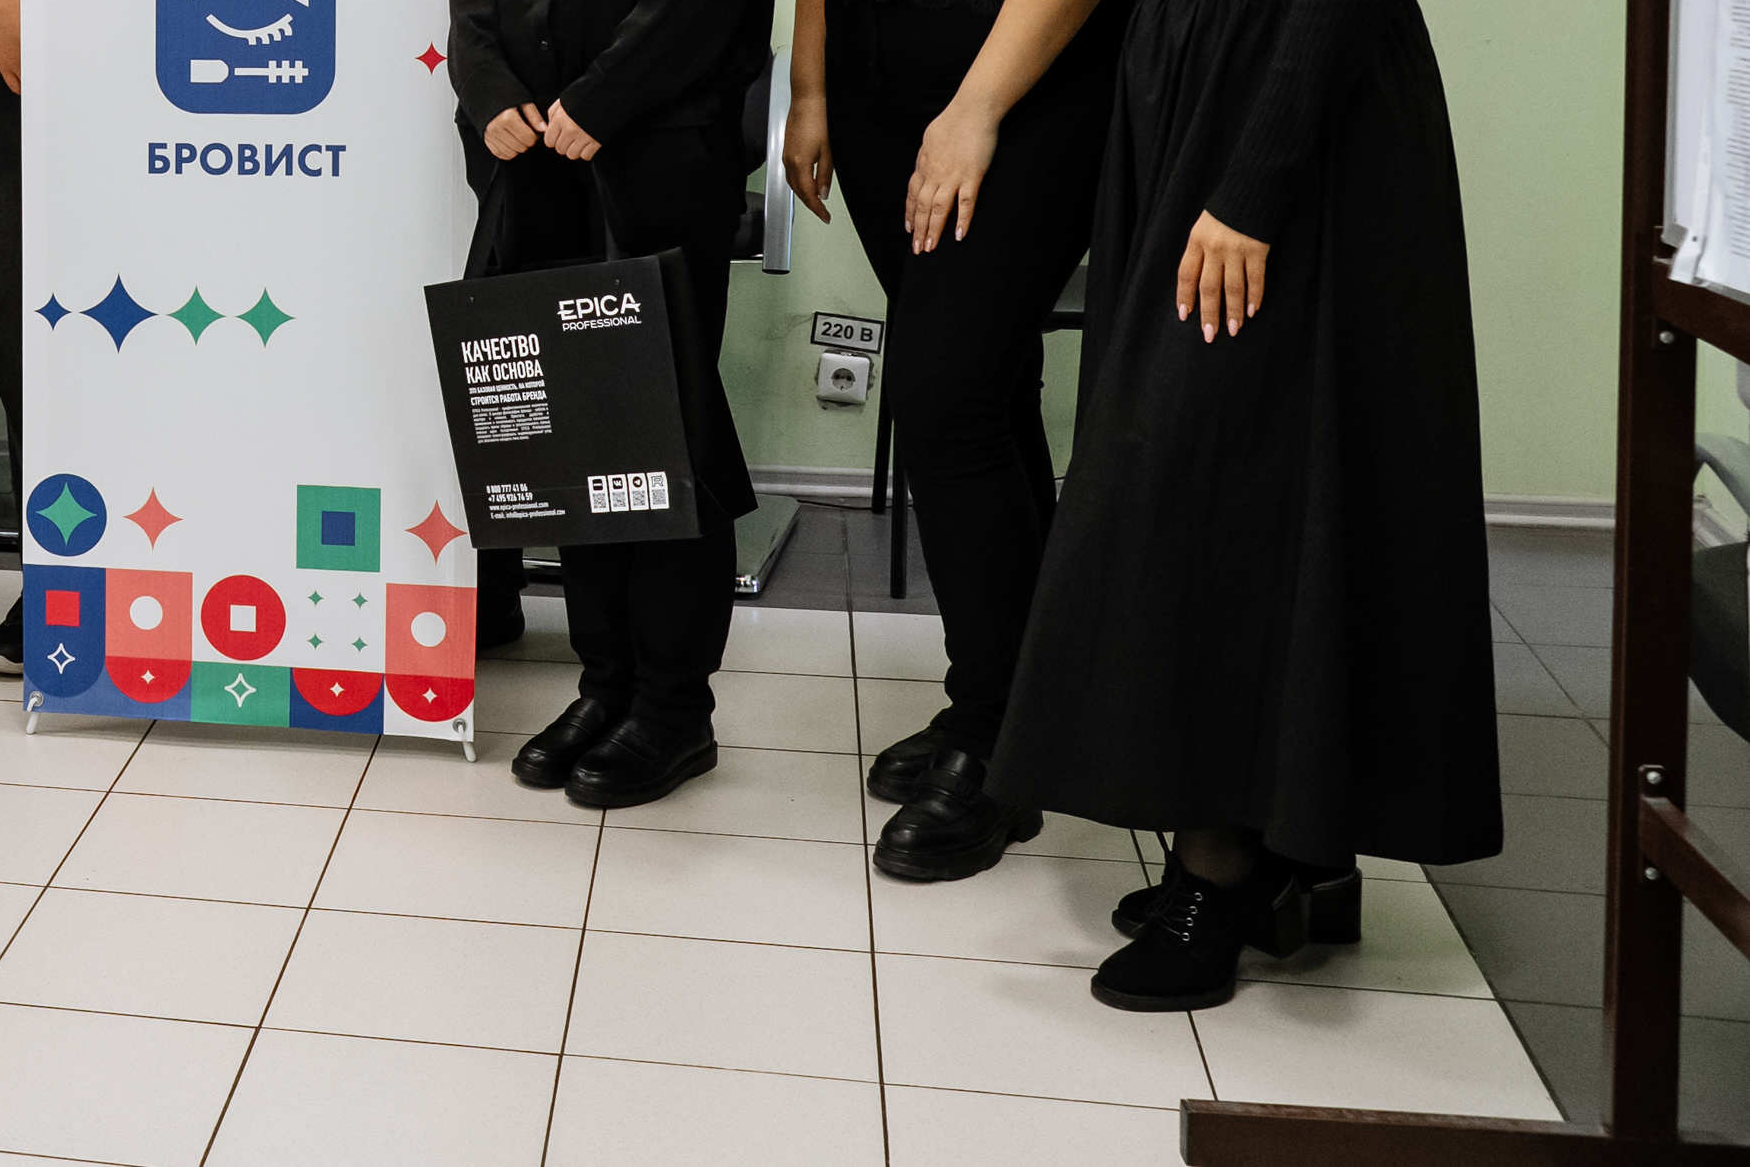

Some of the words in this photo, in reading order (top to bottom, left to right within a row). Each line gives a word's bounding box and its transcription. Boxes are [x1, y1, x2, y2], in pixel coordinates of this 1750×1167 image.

[148, 142, 347, 177] БРОВИСТ
[557, 293, 641, 321] EPICA
[562, 315, 642, 332] PROFESSIONAL
[821, 321, 854, 340] 220
[860, 327, 874, 342] В
[461, 333, 540, 363] КАЧЕСТВО
[465, 364, 491, 384] КАК
[492, 359, 543, 381] ОСНОВА
[470, 395, 499, 406] СТРОИТСЯ
[499, 392, 522, 403] РАБОТА
[522, 390, 547, 401] БРЕНДА
